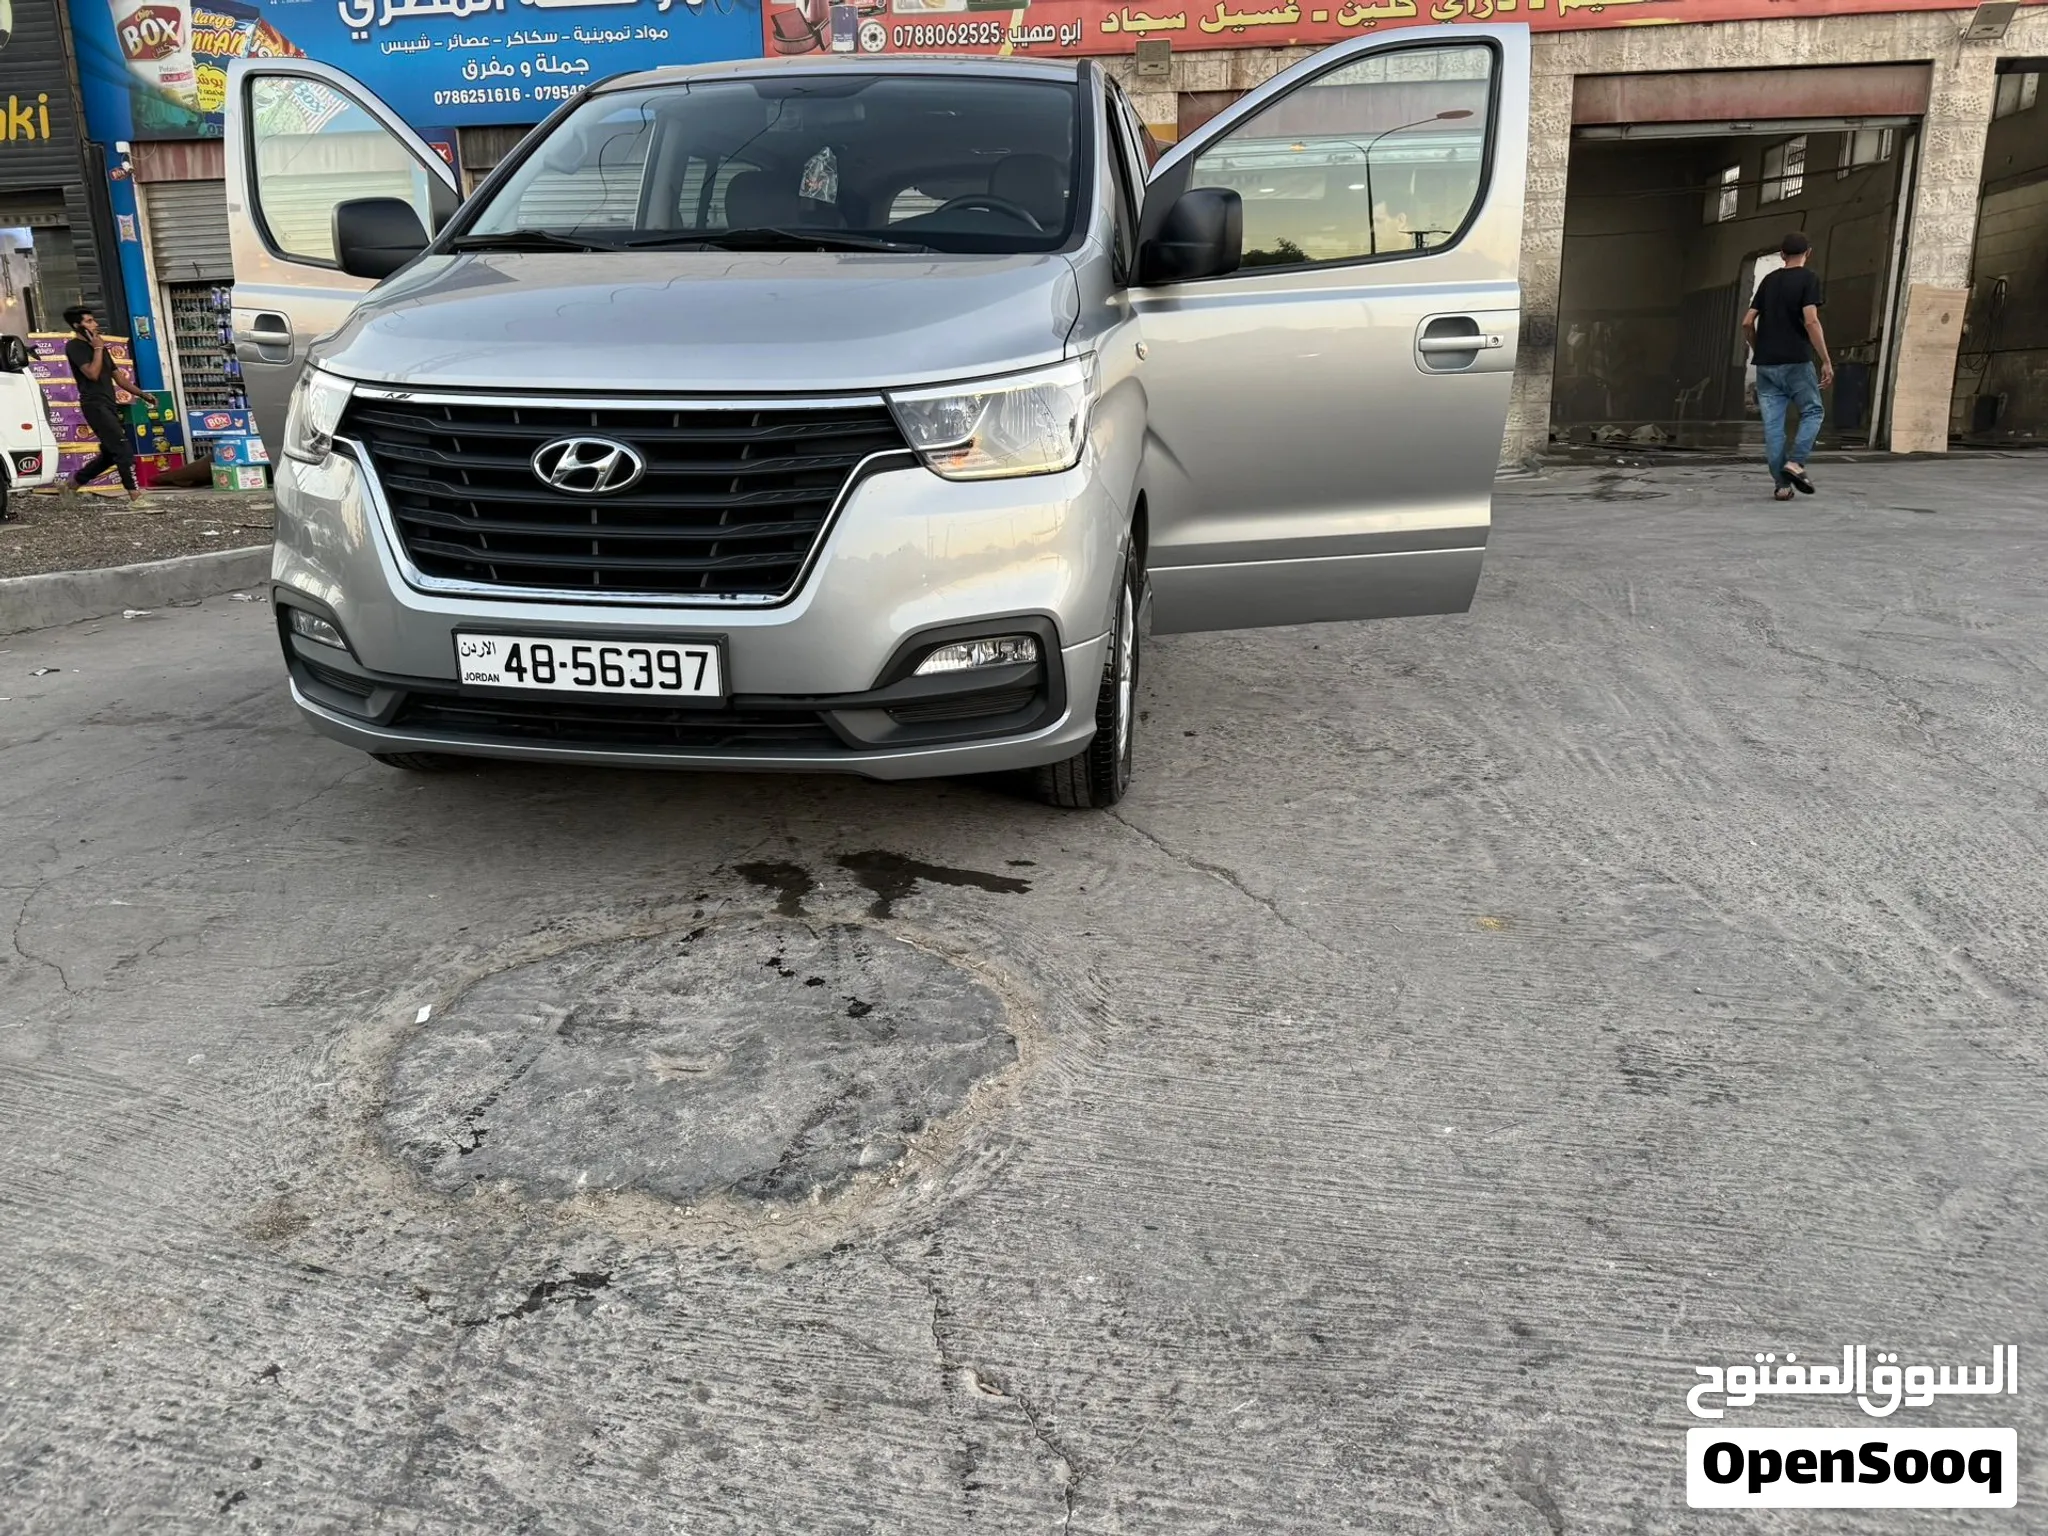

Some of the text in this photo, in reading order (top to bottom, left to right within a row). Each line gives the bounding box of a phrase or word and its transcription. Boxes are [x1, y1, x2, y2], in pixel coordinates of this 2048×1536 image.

[135, 9, 154, 21] Chips
[192, 8, 236, 29] large
[1101, 7, 1187, 36] سجاد
[1199, 0, 1301, 33] غسيل
[122, 18, 178, 56] BOX
[506, 31, 558, 47] سكاكر
[573, 26, 631, 44] تموينية
[634, 25, 669, 40] مواد
[893, 22, 1000, 47] 0788062525
[1060, 19, 1082, 47] ابو
[381, 34, 431, 54] شيبس
[447, 34, 490, 51] عصائر
[462, 53, 590, 80] جملة و مفرق
[434, 87, 520, 105] 0786251616
[208, 416, 228, 428] BOX
[22, 460, 37, 470] KIA
[504, 643, 709, 691] 48-56397
[464, 671, 500, 683] JORDAN
